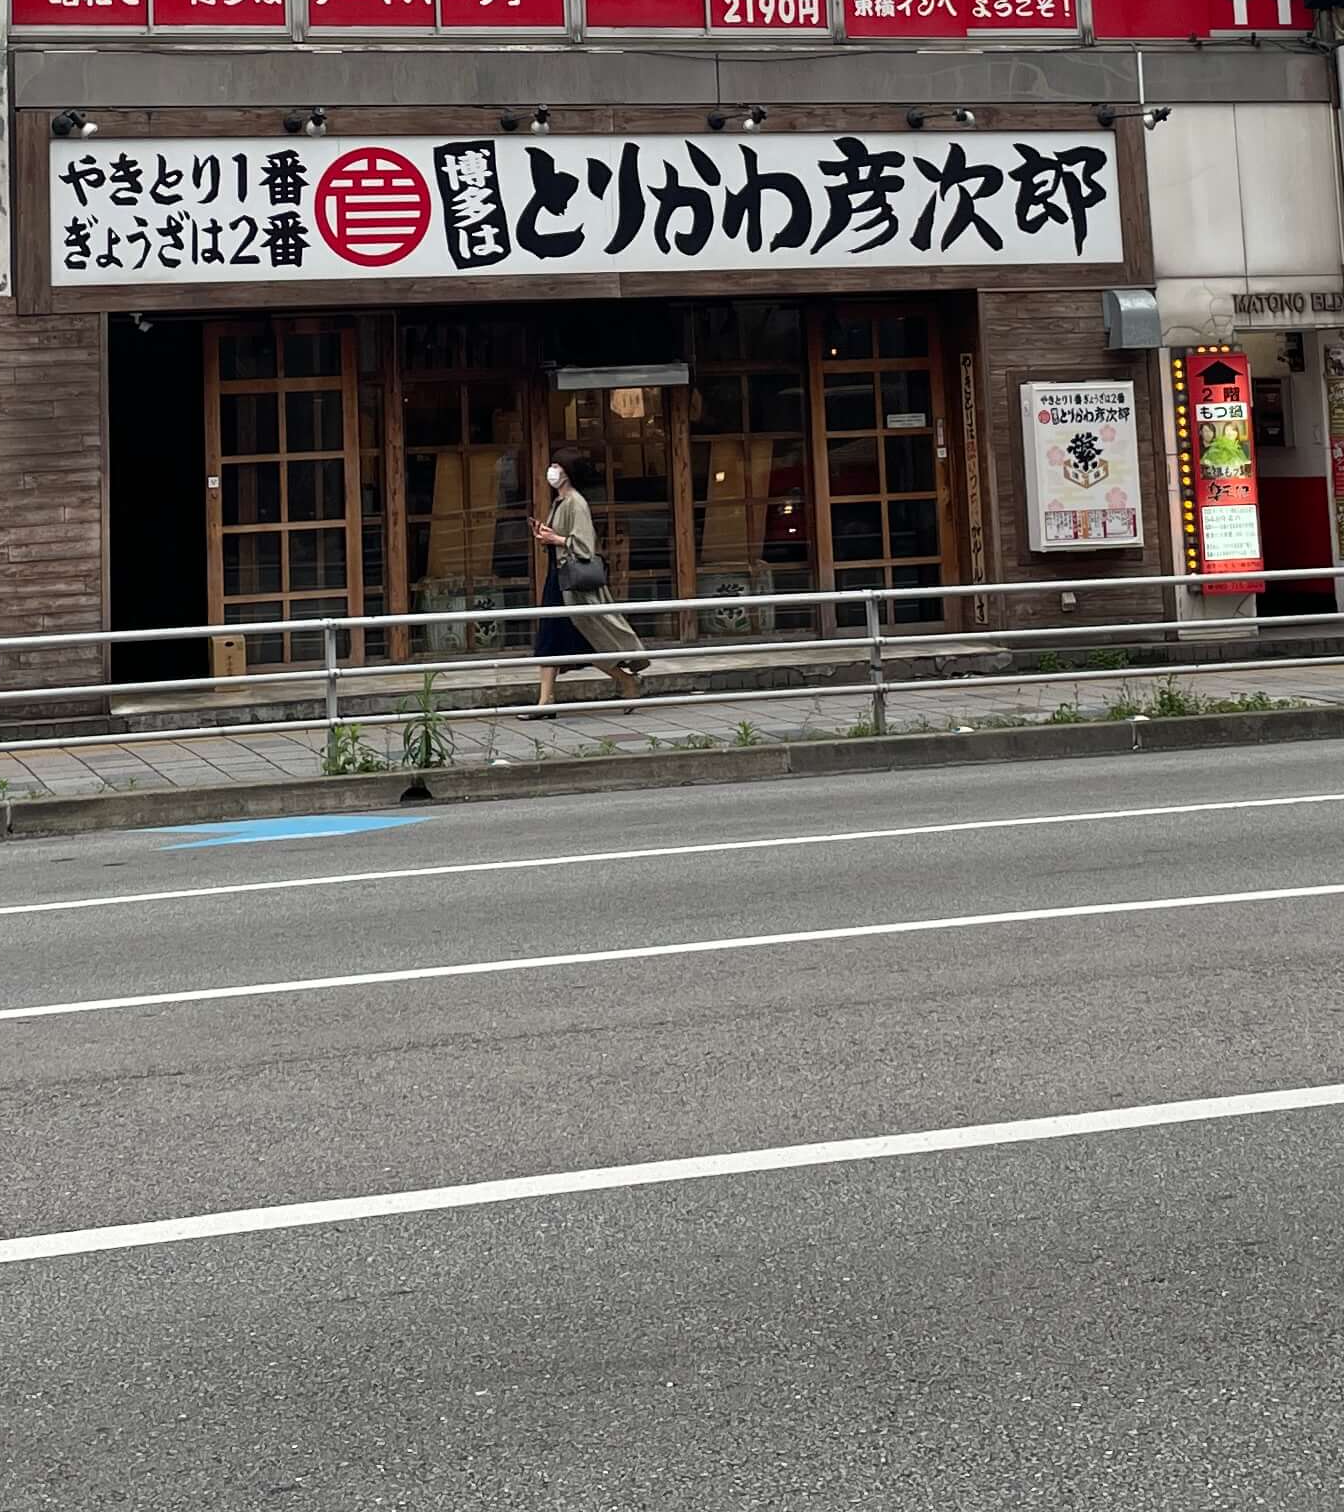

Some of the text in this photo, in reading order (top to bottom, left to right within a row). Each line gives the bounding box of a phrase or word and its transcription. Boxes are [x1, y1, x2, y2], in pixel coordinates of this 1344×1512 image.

[59, 149, 311, 207] やきとり1番
[515, 136, 1108, 260] とりかわ彦次郎
[62, 210, 311, 270] ぎょうざは2番
[1232, 292, 1305, 314] MATONO
[1200, 405, 1244, 419] もつ鍋
